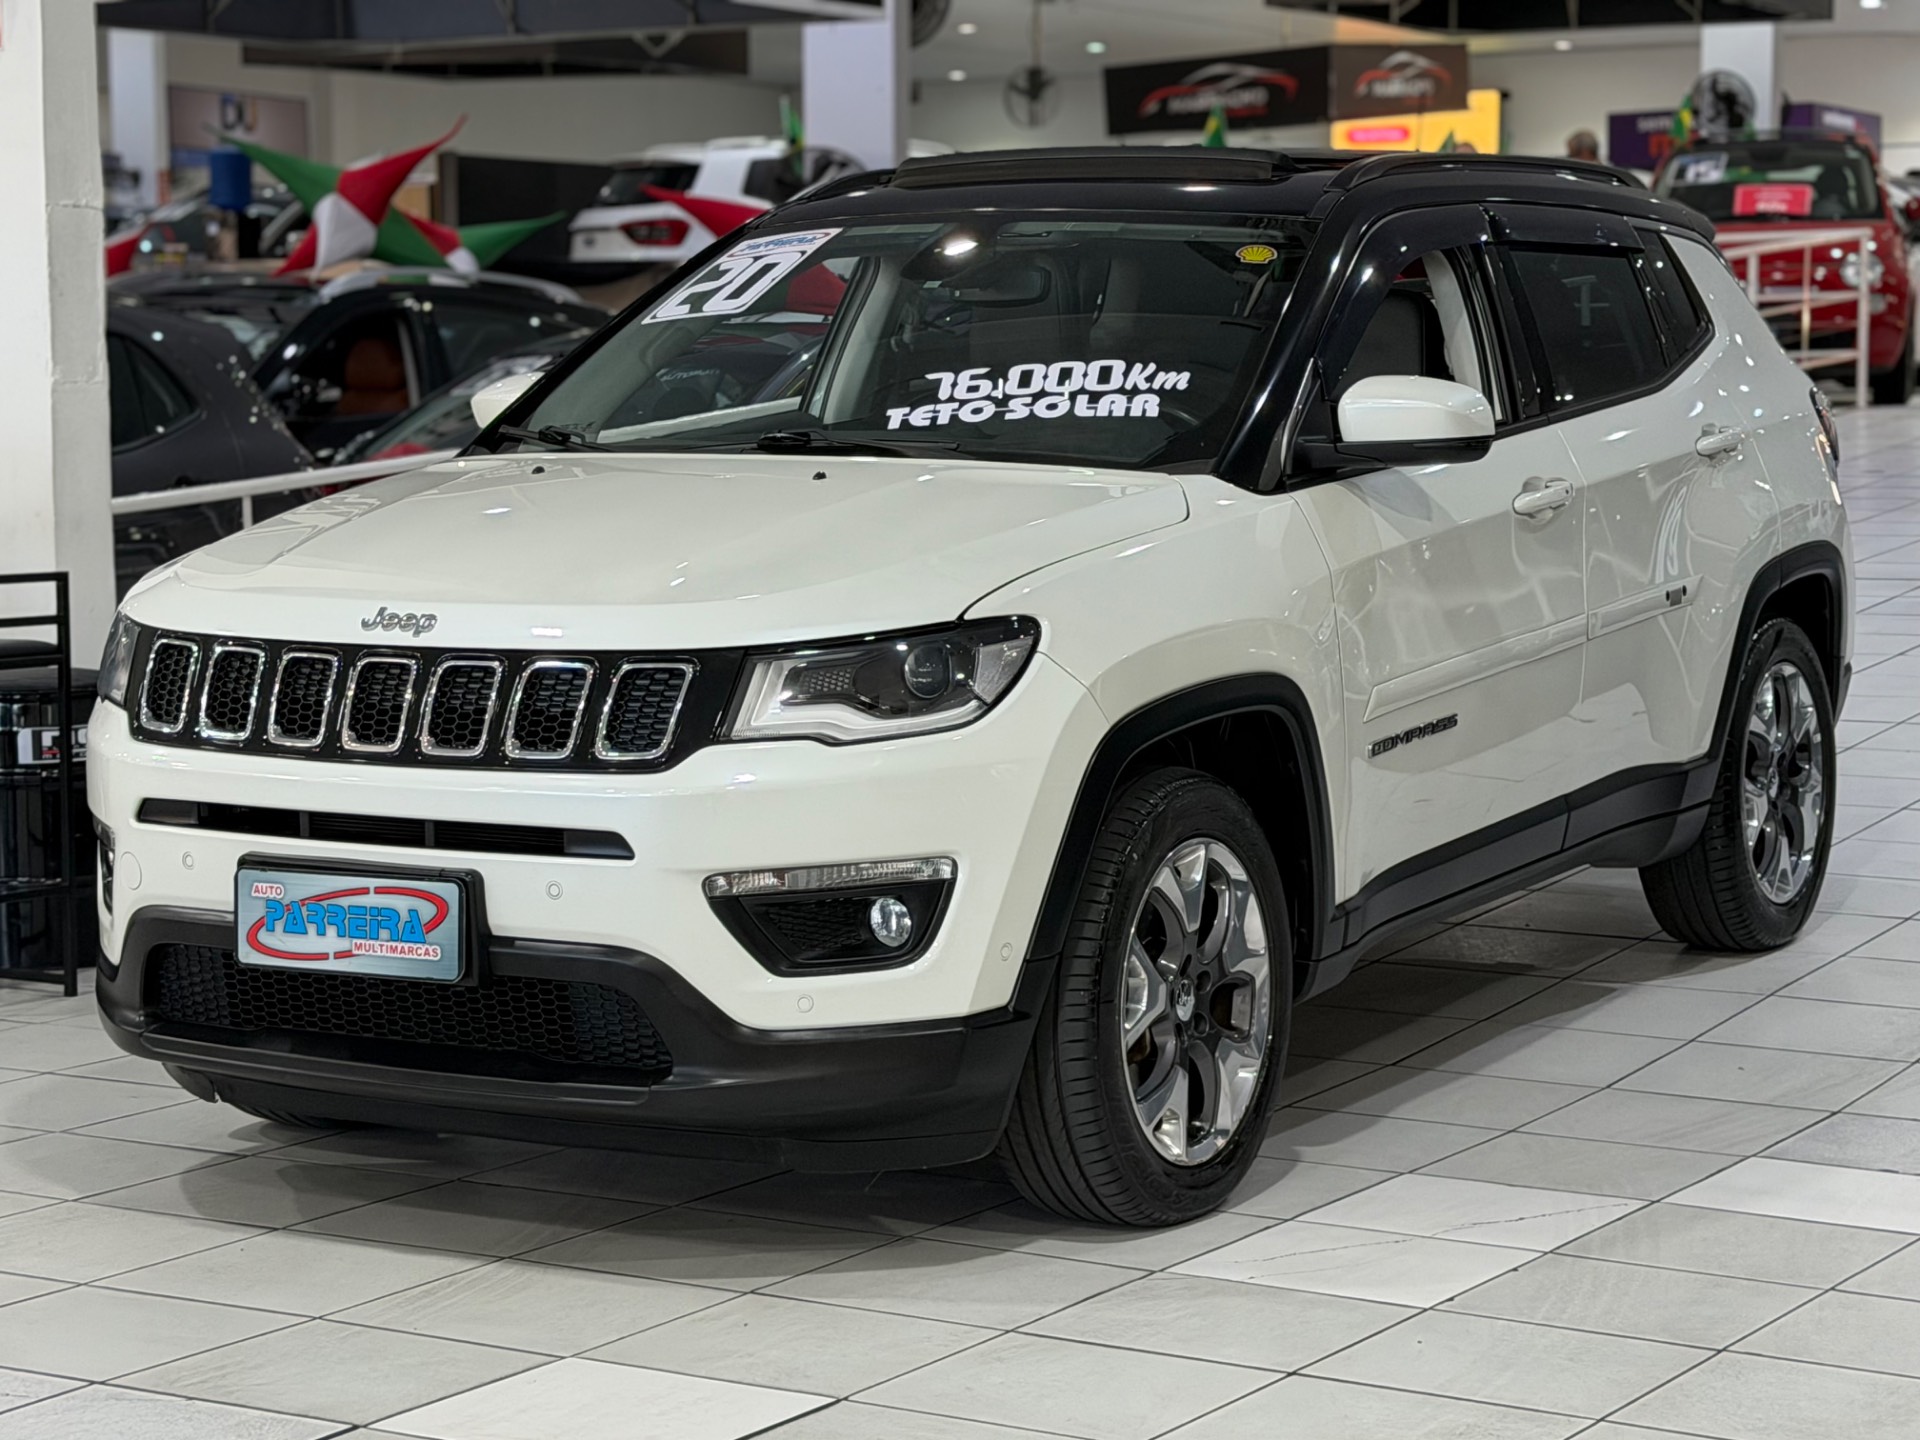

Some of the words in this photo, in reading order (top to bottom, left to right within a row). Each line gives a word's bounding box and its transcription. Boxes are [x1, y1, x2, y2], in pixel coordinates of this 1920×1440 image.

[655, 251, 802, 318] 20
[886, 400, 996, 430] TETO
[1004, 394, 1160, 420] SOLAR
[361, 606, 438, 638] Jeep
[1366, 713, 1458, 759] COMPASS
[253, 884, 283, 897] AUTO
[265, 899, 426, 944] PARREIRA
[353, 941, 440, 958] MULTIMARCAS
